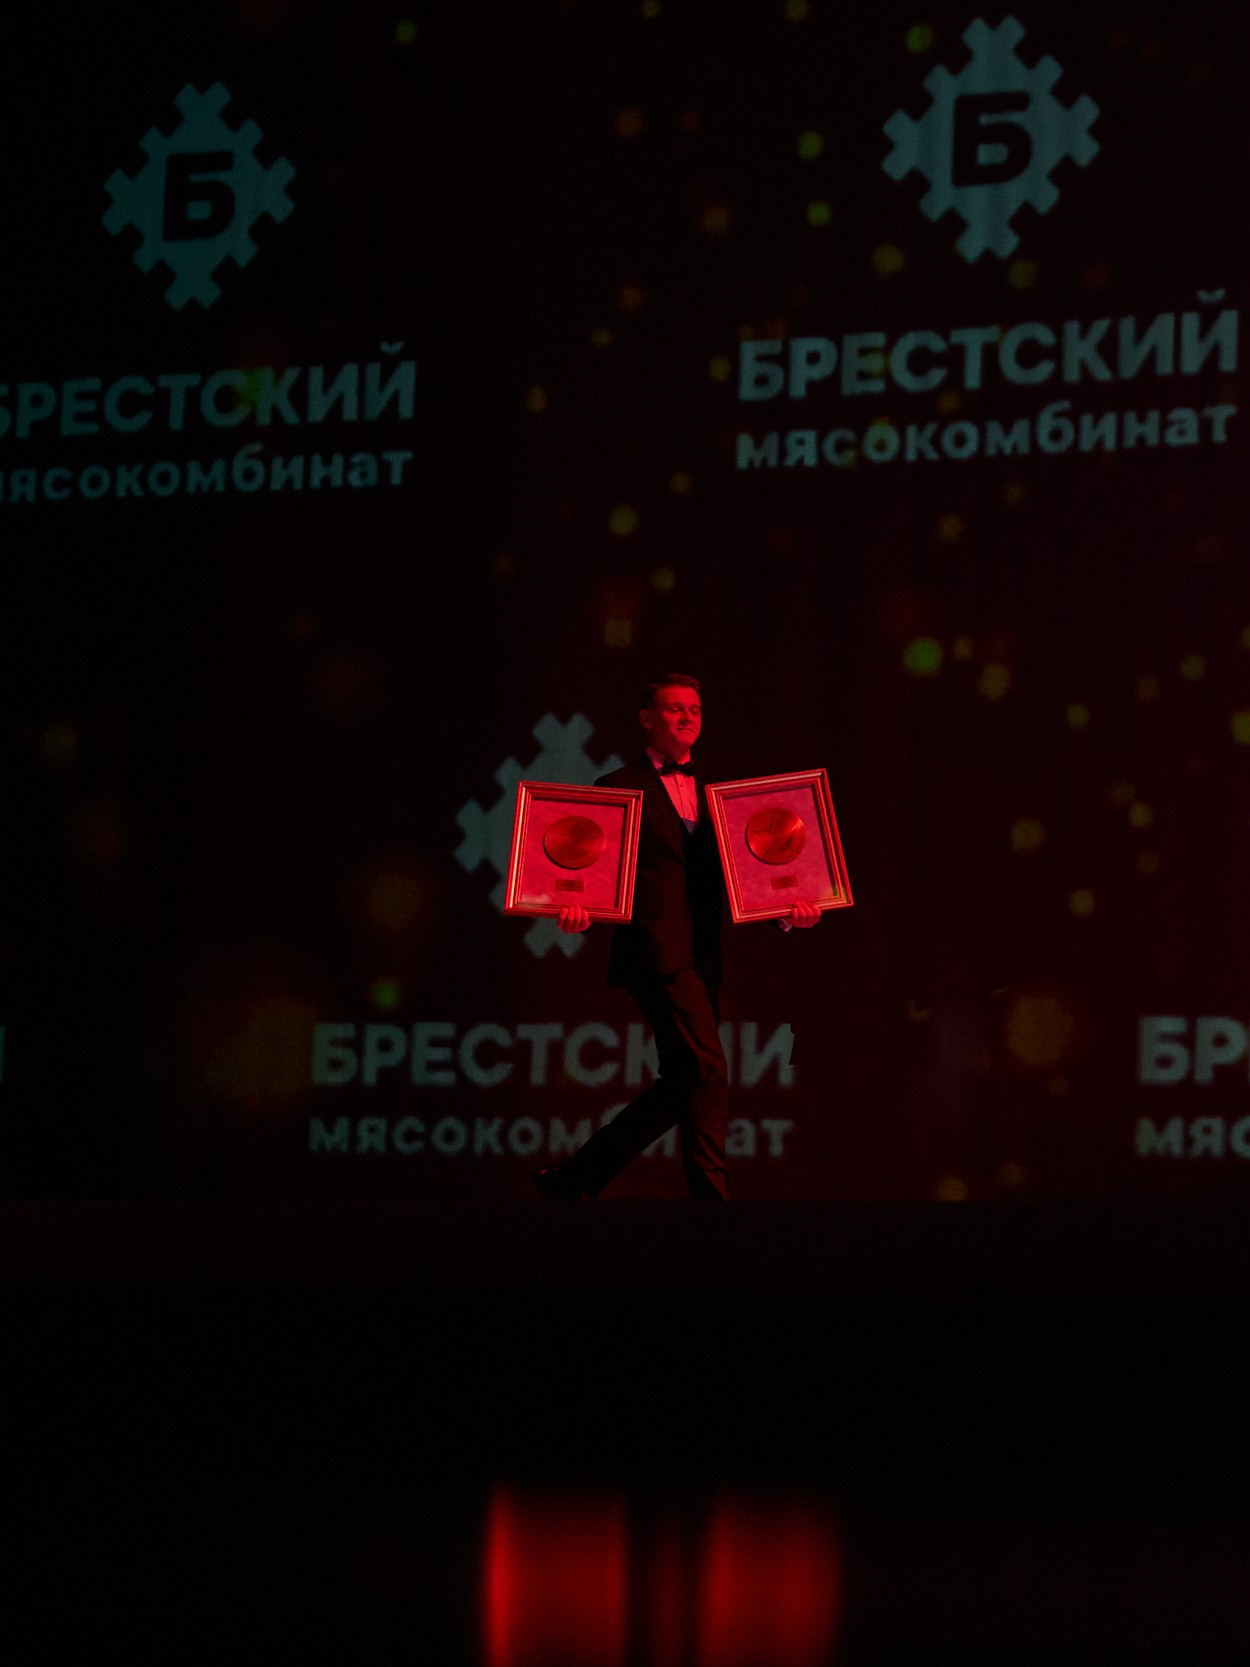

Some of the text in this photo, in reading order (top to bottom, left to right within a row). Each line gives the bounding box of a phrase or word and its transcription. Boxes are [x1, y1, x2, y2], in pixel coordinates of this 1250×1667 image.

[950, 90, 1034, 189] Б
[161, 149, 236, 243] Б
[0, 340, 418, 438] РЕСТСКИЙ
[738, 288, 1239, 401] БРЕСТСКИЙ
[0, 443, 414, 503] ясокомбинат
[736, 400, 1238, 469] мясокомбинат
